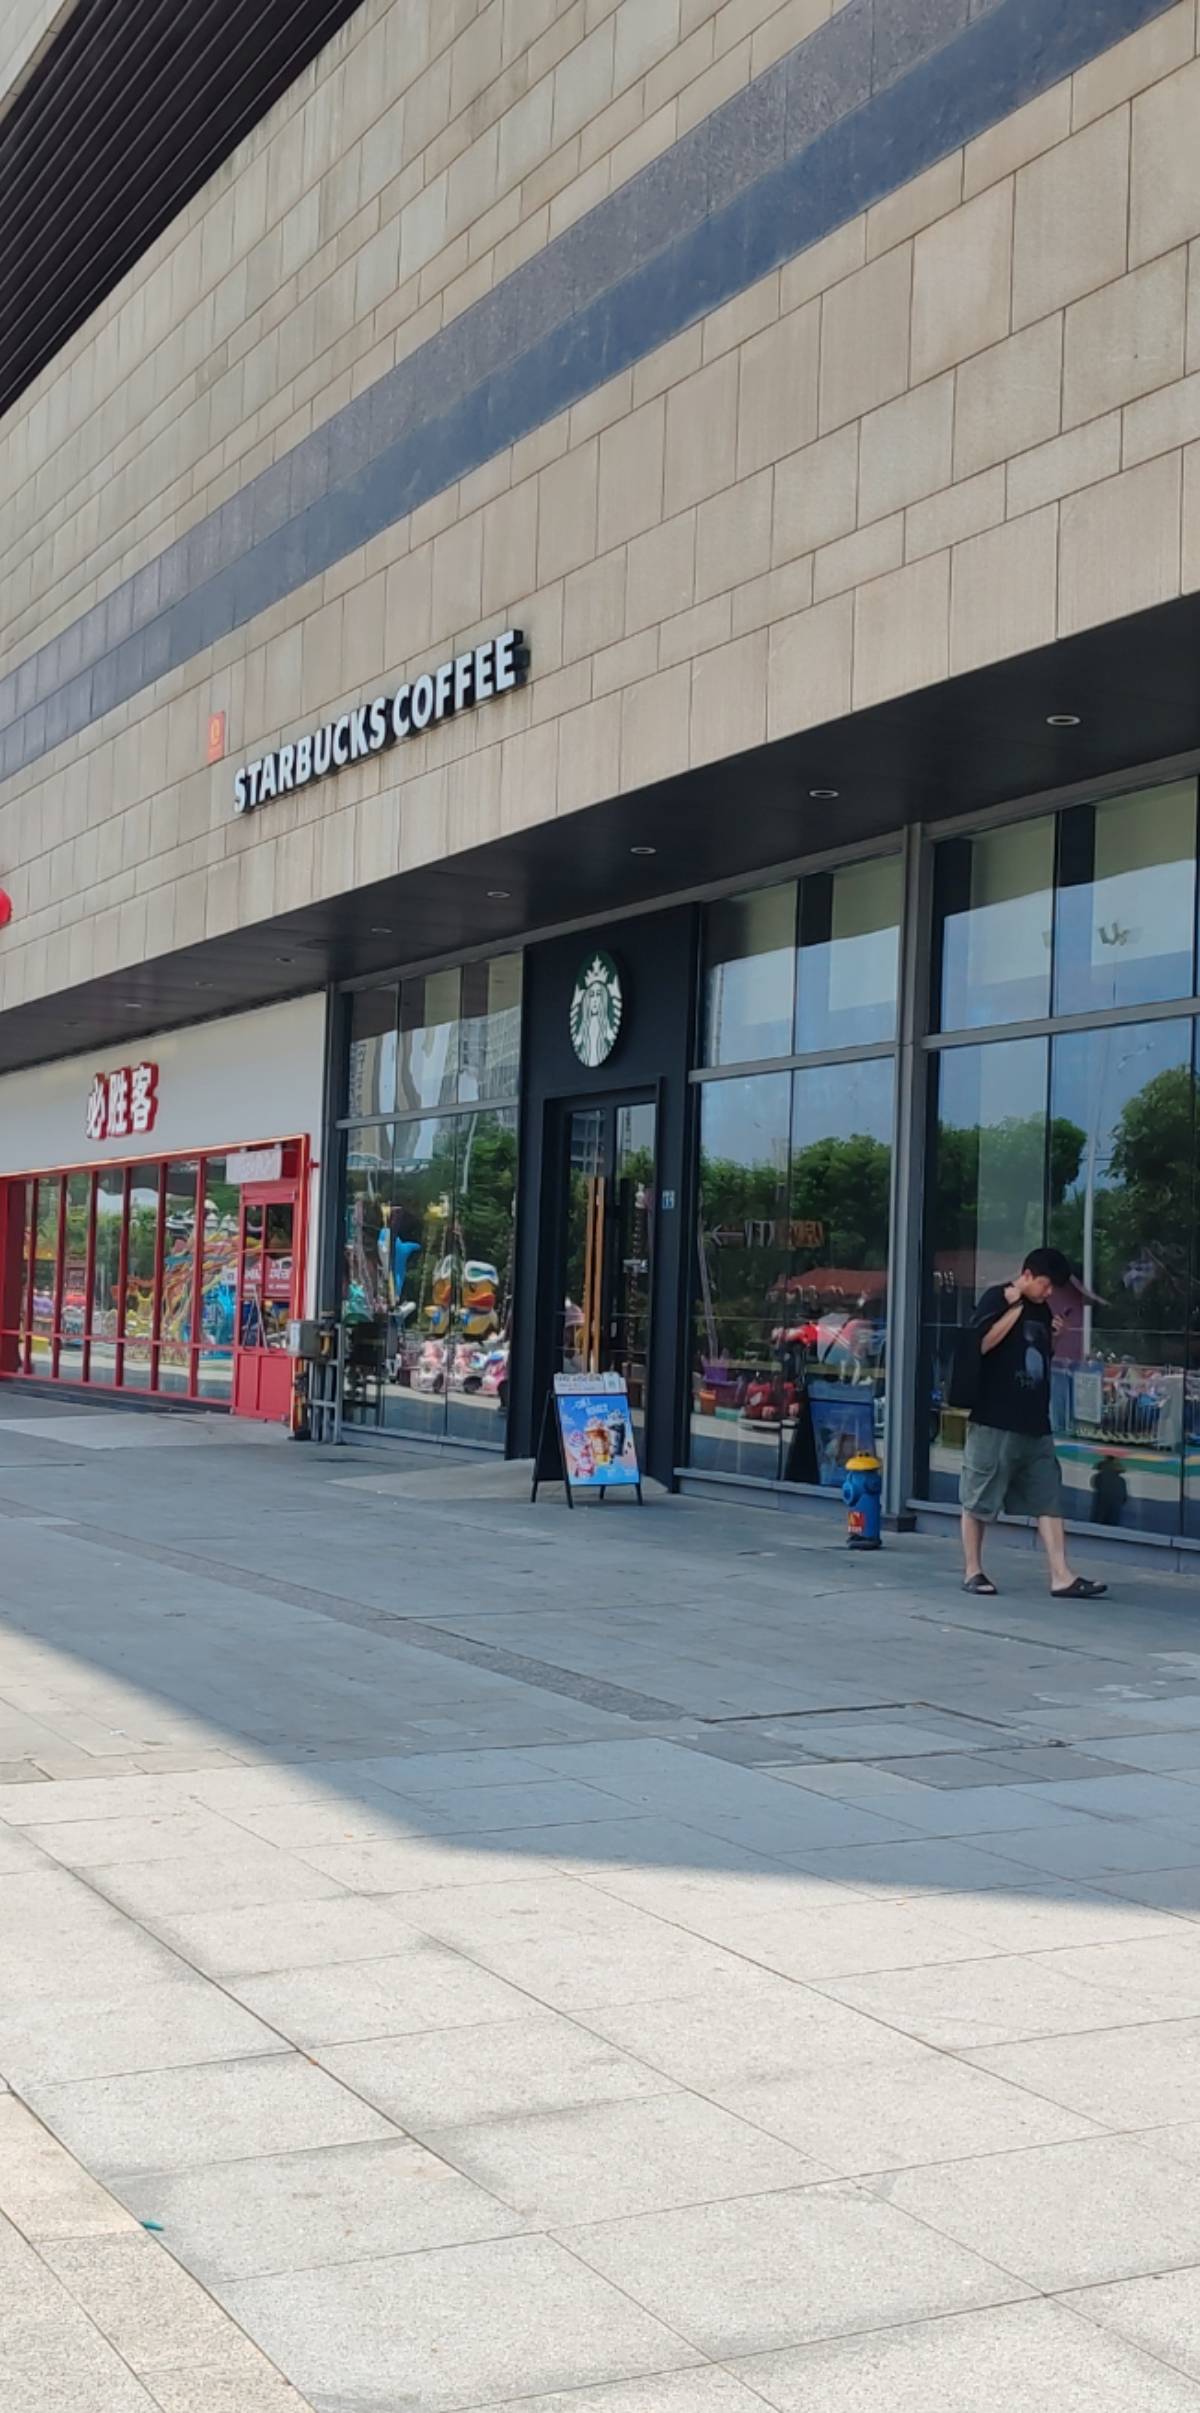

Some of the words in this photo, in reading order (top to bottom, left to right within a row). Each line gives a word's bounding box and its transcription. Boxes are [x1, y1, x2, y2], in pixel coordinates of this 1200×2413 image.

[234, 696, 387, 813] STARBUCKS
[391, 629, 522, 737] COFFEE
[86, 1063, 157, 1139] 必胜客
